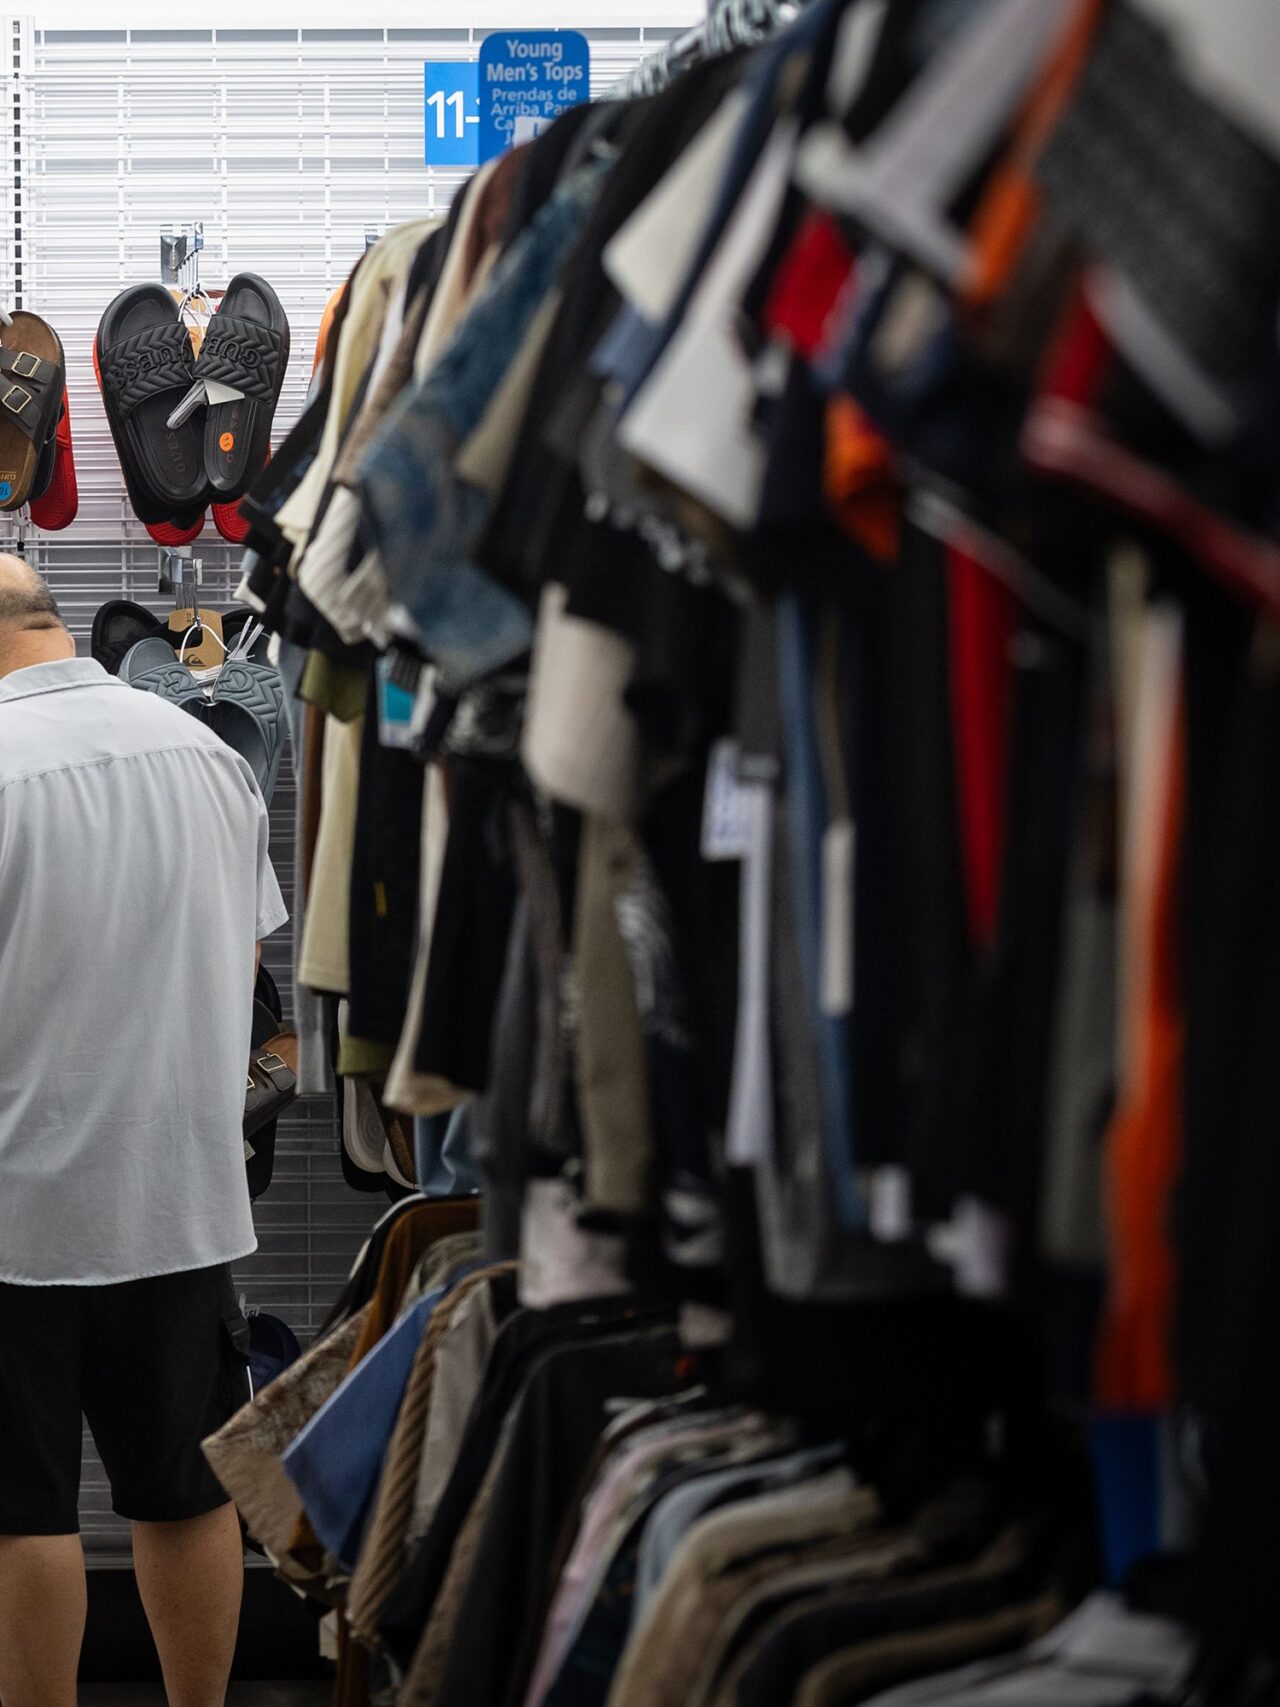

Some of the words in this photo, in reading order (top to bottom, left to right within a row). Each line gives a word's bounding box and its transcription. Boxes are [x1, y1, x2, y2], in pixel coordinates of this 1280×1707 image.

[506, 39, 563, 61] Young
[486, 62, 538, 82] Men's
[543, 62, 583, 85] Tops
[491, 87, 553, 102] Prendas
[557, 86, 578, 101] de
[426, 90, 480, 138] 11-
[490, 101, 540, 116] Arriba
[544, 101, 574, 115] Par
